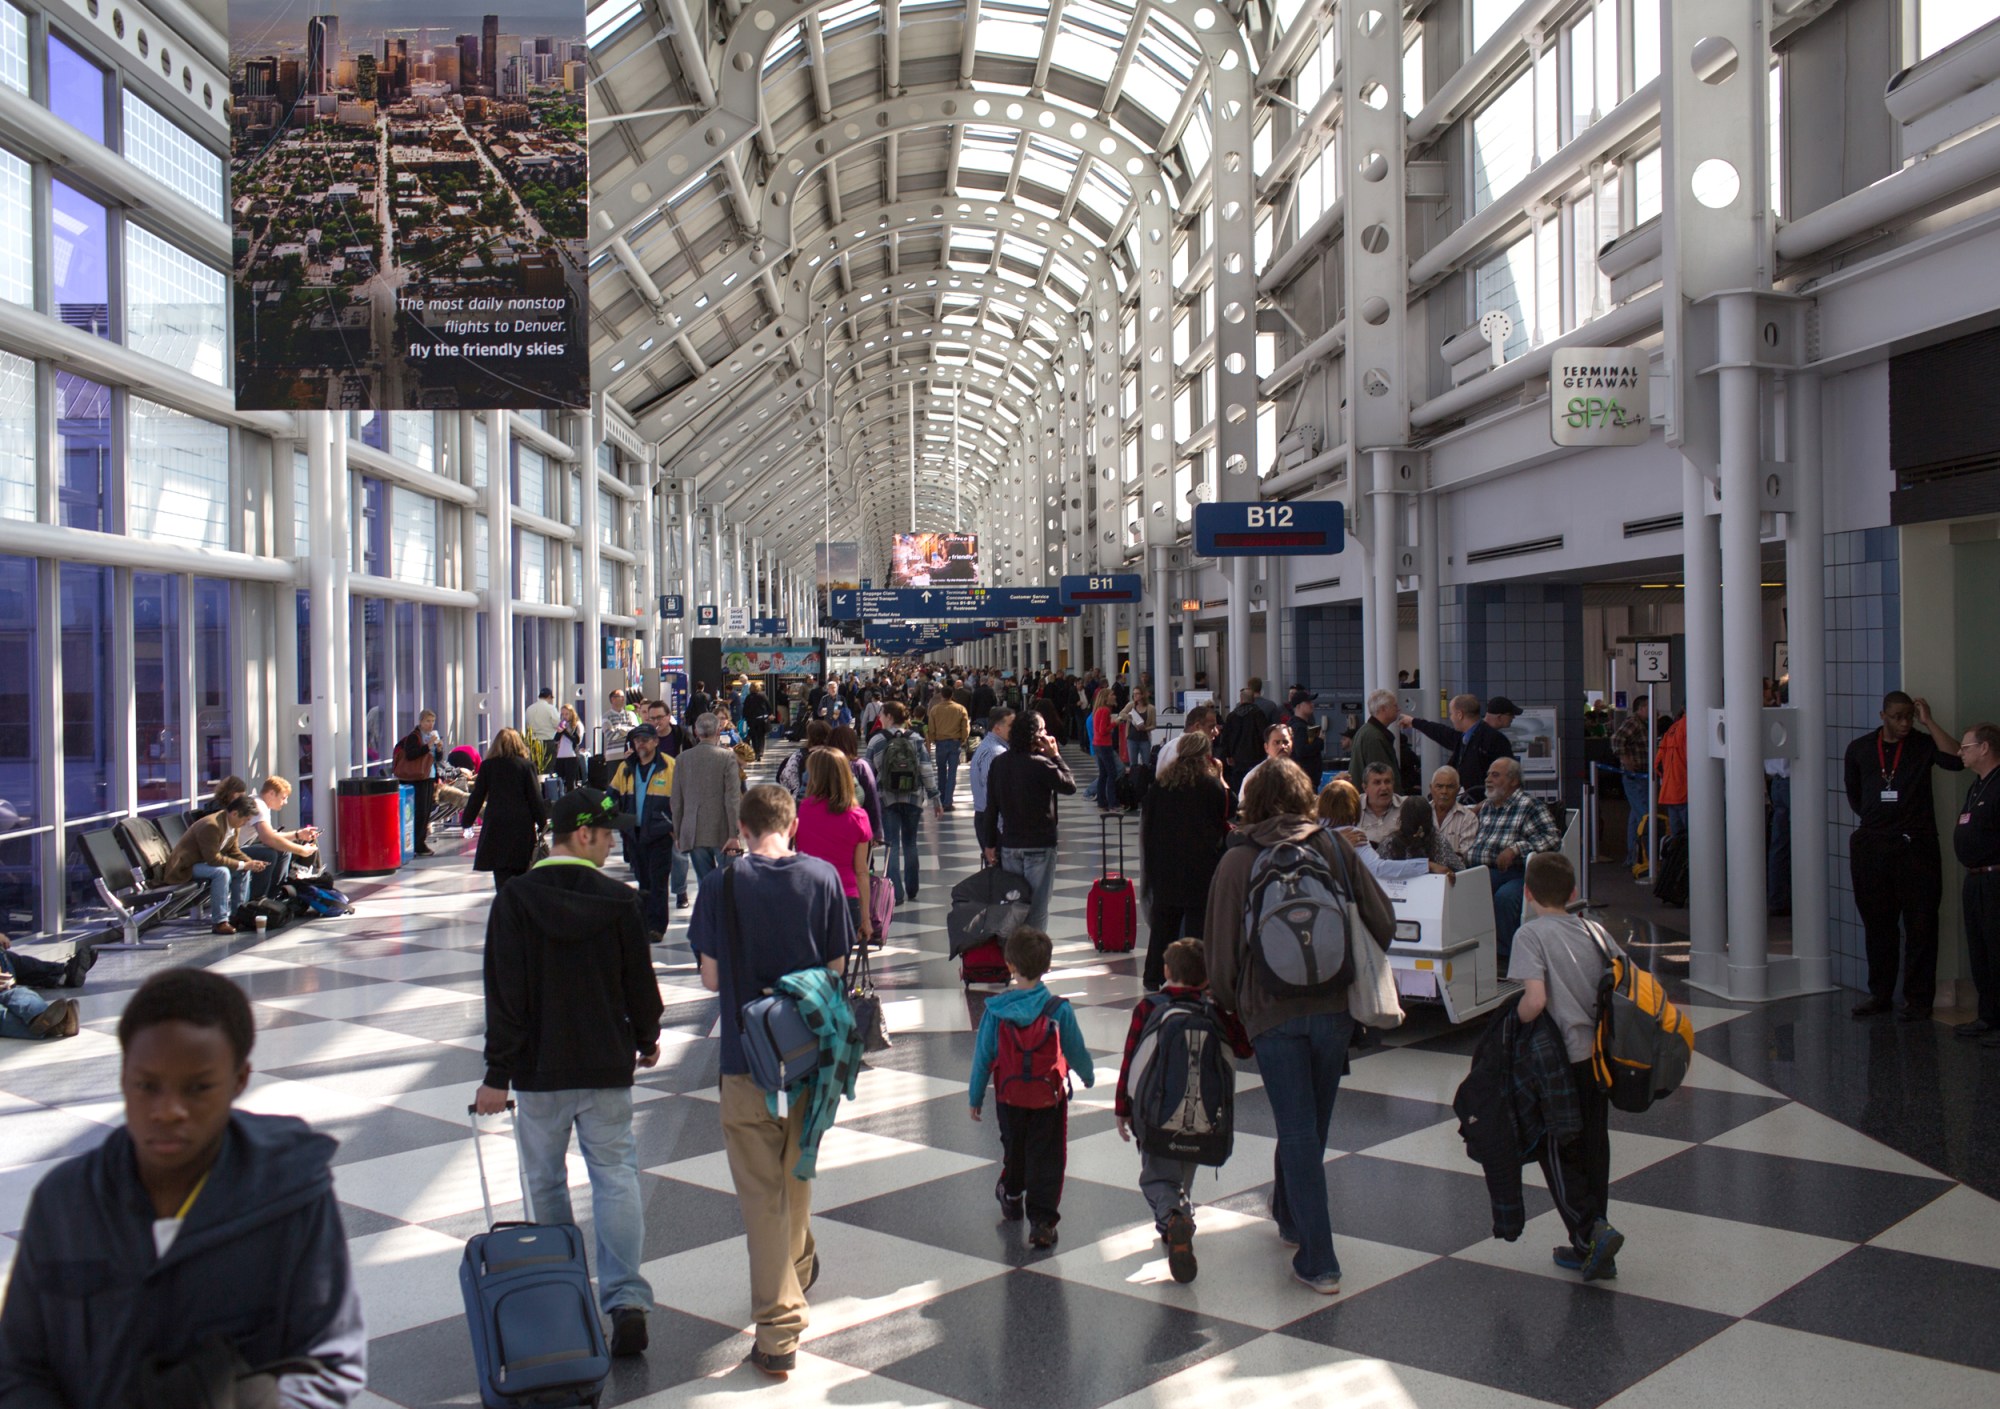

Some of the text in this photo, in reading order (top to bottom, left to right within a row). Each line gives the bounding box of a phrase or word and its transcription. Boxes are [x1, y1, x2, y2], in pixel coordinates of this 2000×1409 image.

[398, 297, 566, 312] The most daily nonstop
[444, 320, 567, 335] flights to Denver.
[409, 342, 565, 359] fly the friendly skies
[1563, 366, 1639, 377] TERMINAL
[1563, 377, 1639, 389] GETAWAY
[1567, 396, 1627, 428] SPA
[1247, 506, 1294, 528] B12
[1089, 577, 1113, 590] B11
[1648, 657, 1659, 671] 3
